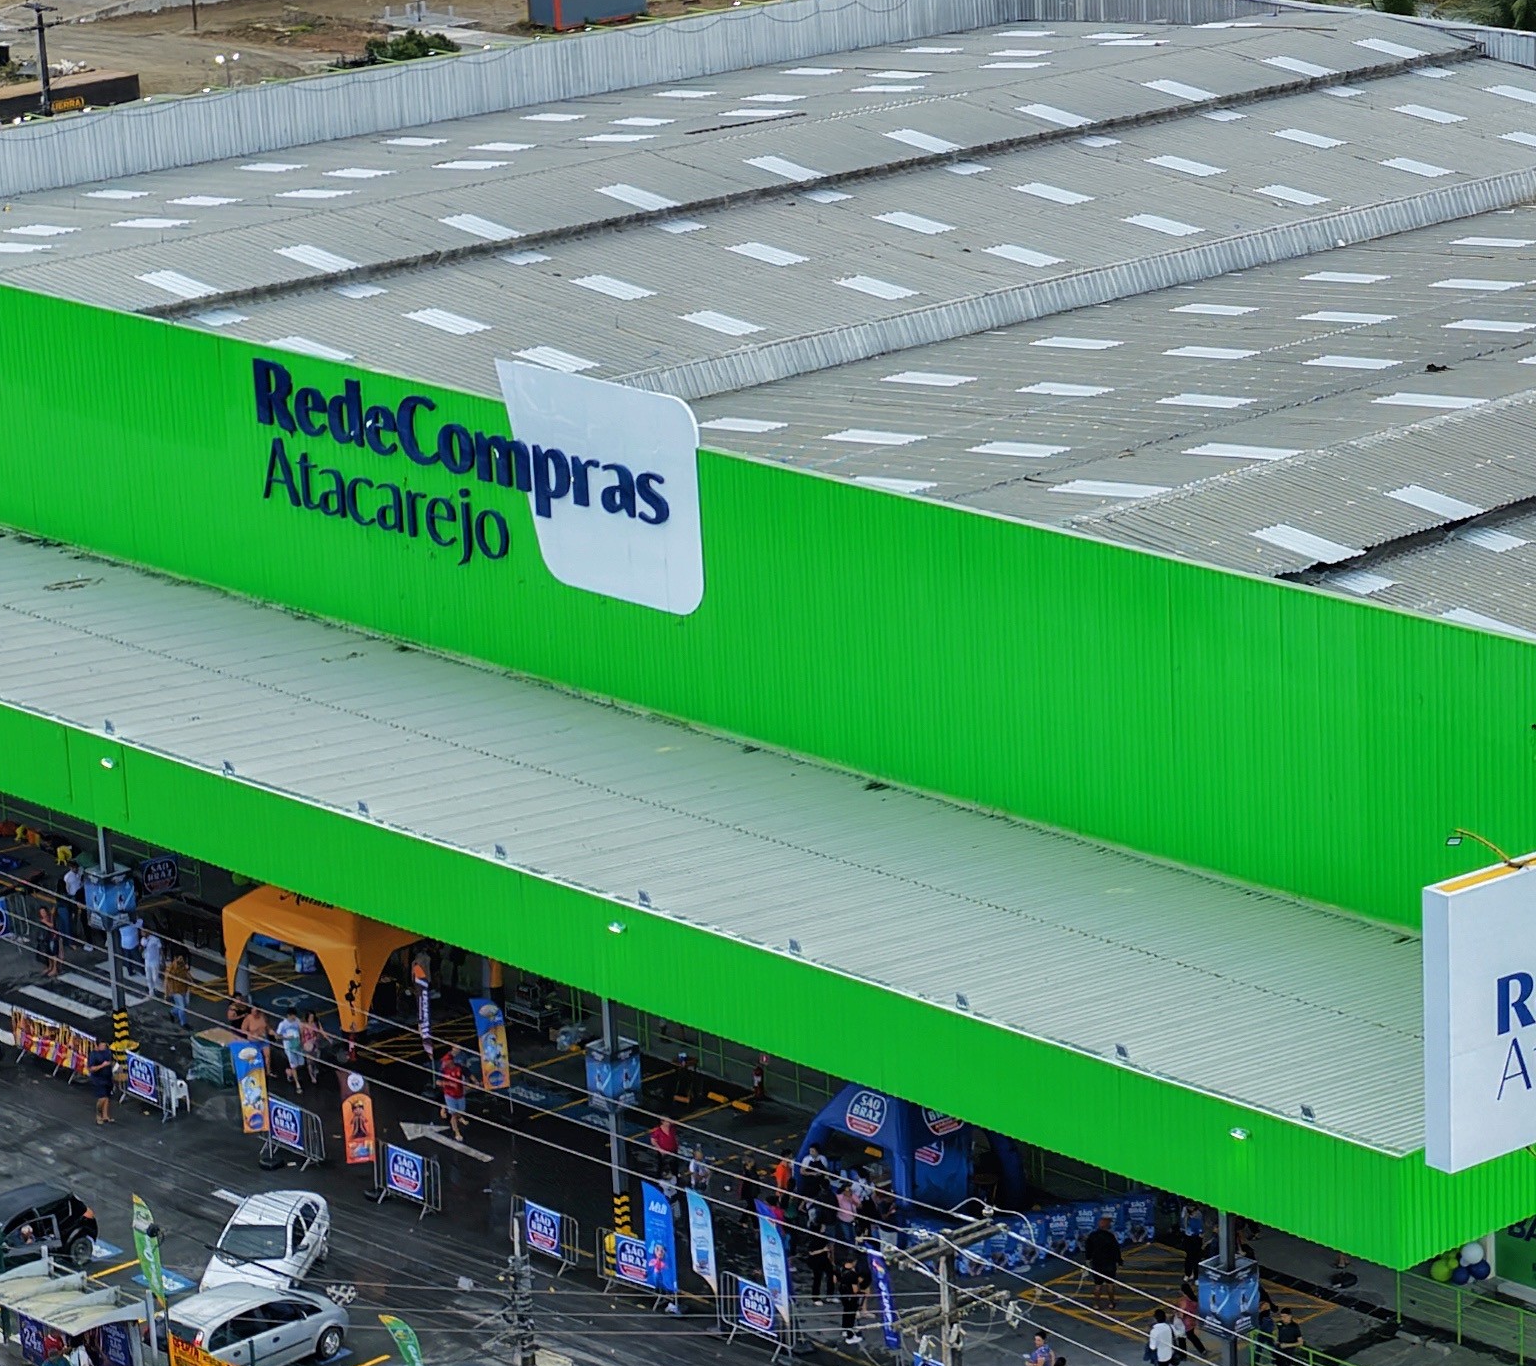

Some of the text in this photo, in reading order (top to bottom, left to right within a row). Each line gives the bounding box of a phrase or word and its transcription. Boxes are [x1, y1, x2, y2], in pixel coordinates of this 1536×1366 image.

[253, 357, 671, 525] RedeCompras
[264, 436, 511, 566] Atacarejo
[861, 1094, 881, 1109] SÃO
[852, 1103, 882, 1123] BRAZ
[744, 1298, 770, 1314] BRAZ
[747, 1289, 767, 1305] SÃO
